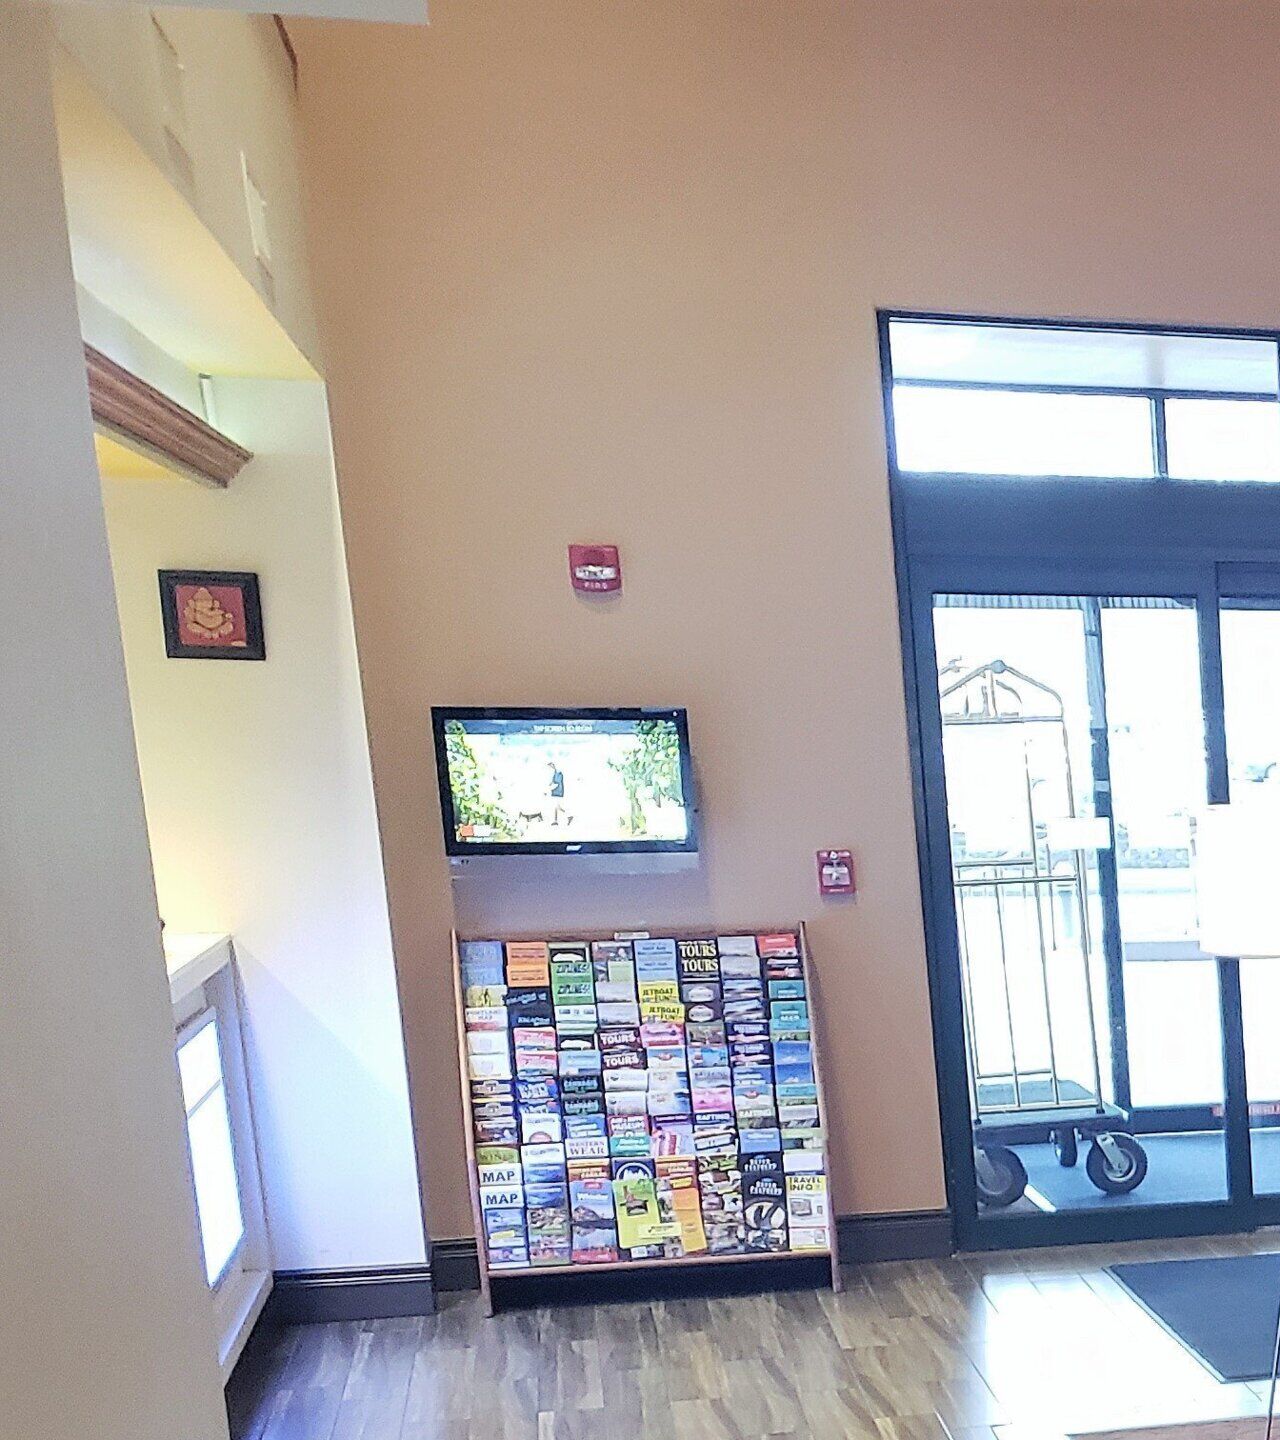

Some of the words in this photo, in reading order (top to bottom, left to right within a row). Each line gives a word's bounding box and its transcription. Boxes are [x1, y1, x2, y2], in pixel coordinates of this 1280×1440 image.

[679, 944, 717, 957] TOURS
[682, 959, 719, 971] TOURS
[601, 1033, 636, 1045] TOURS
[605, 1055, 640, 1067] TOURS
[570, 1147, 604, 1155] WEAR
[482, 1171, 515, 1182] MAP
[486, 1193, 518, 1205] MAP
